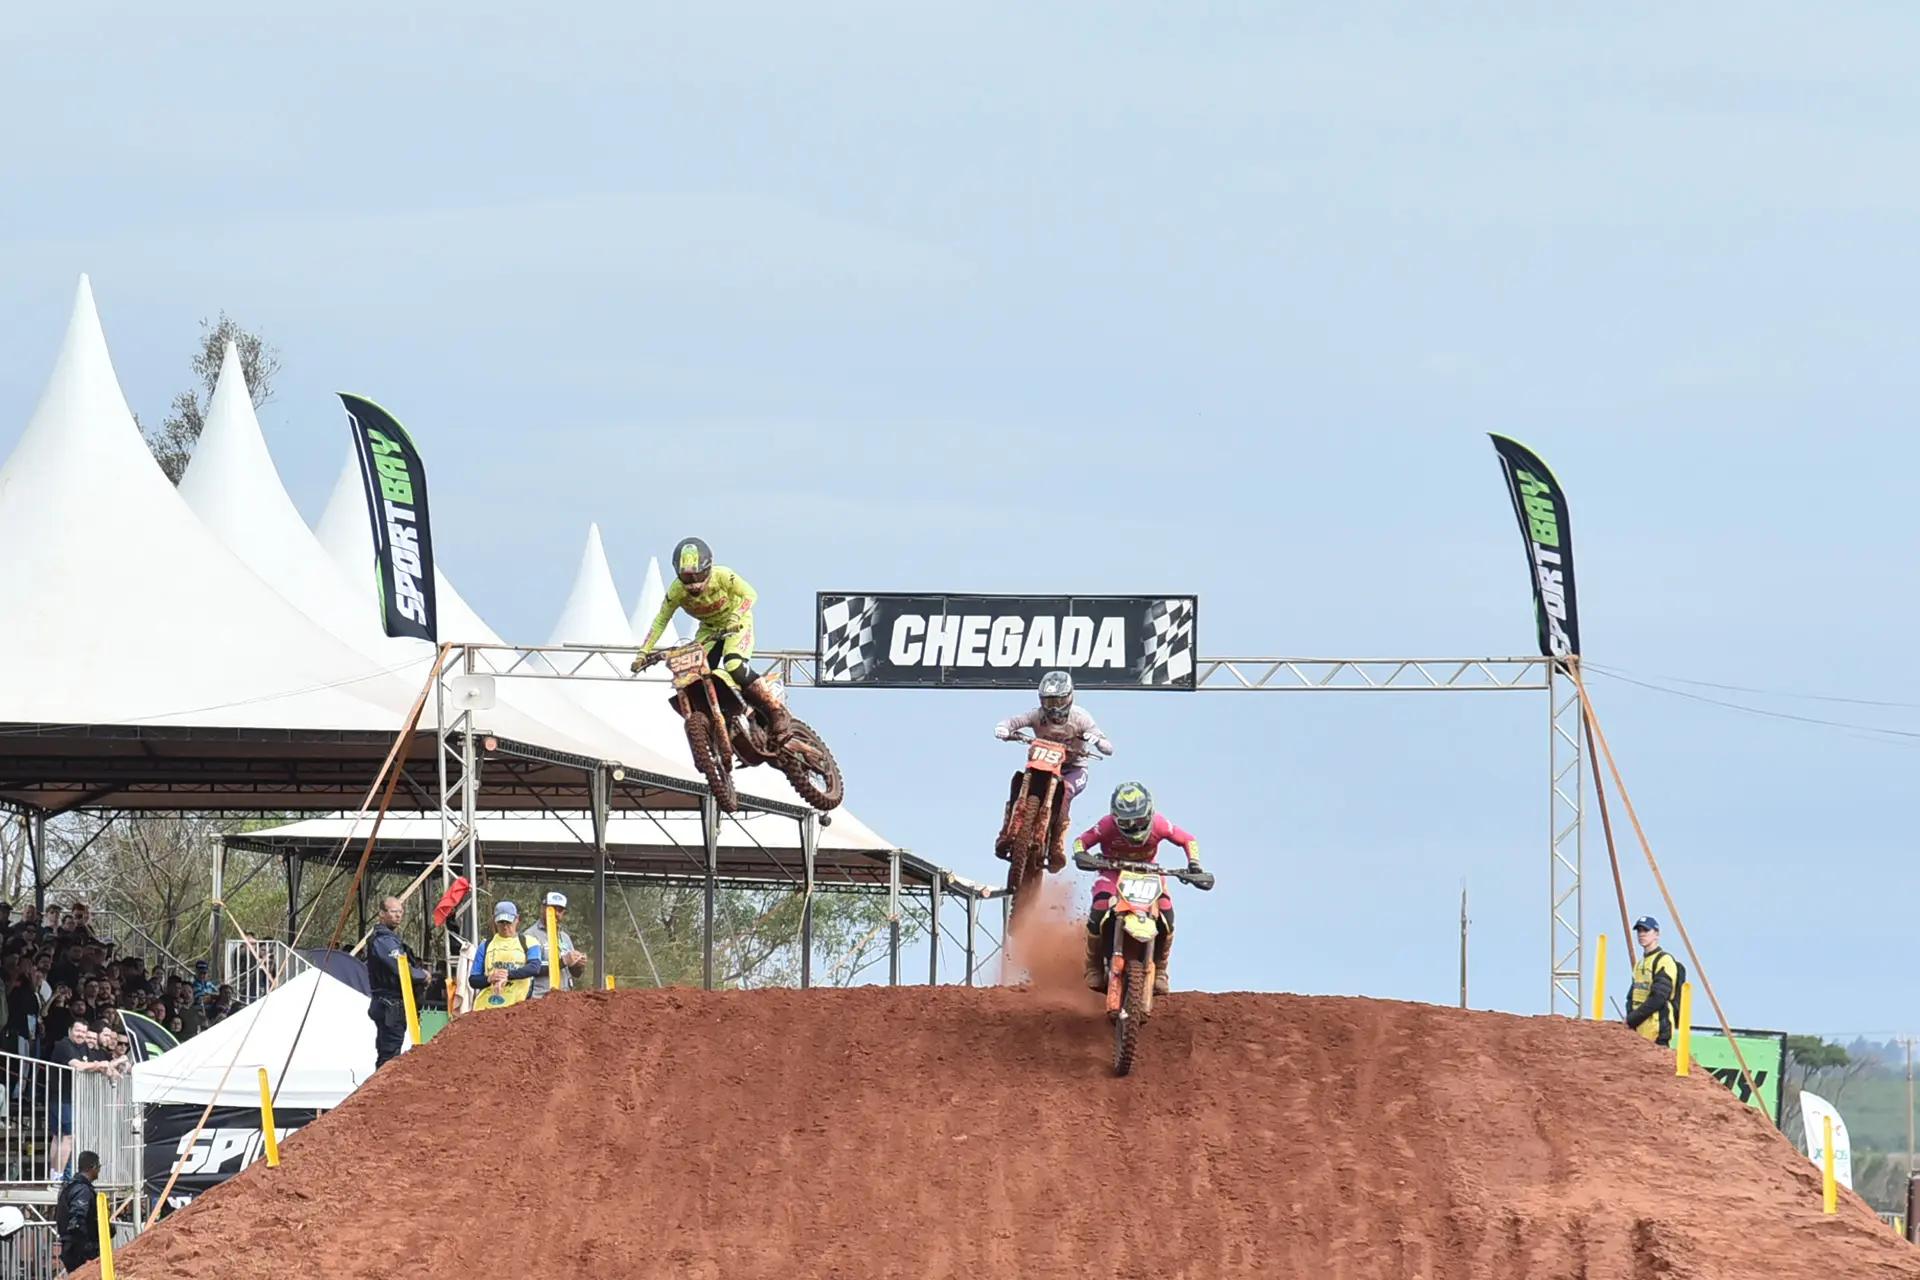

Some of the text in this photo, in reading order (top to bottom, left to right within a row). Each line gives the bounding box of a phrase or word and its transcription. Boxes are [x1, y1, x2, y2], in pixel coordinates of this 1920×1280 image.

[366, 428, 427, 626] SPORTBAY
[889, 614, 1126, 668] CHEGADA
[1122, 879, 1158, 899] 140
